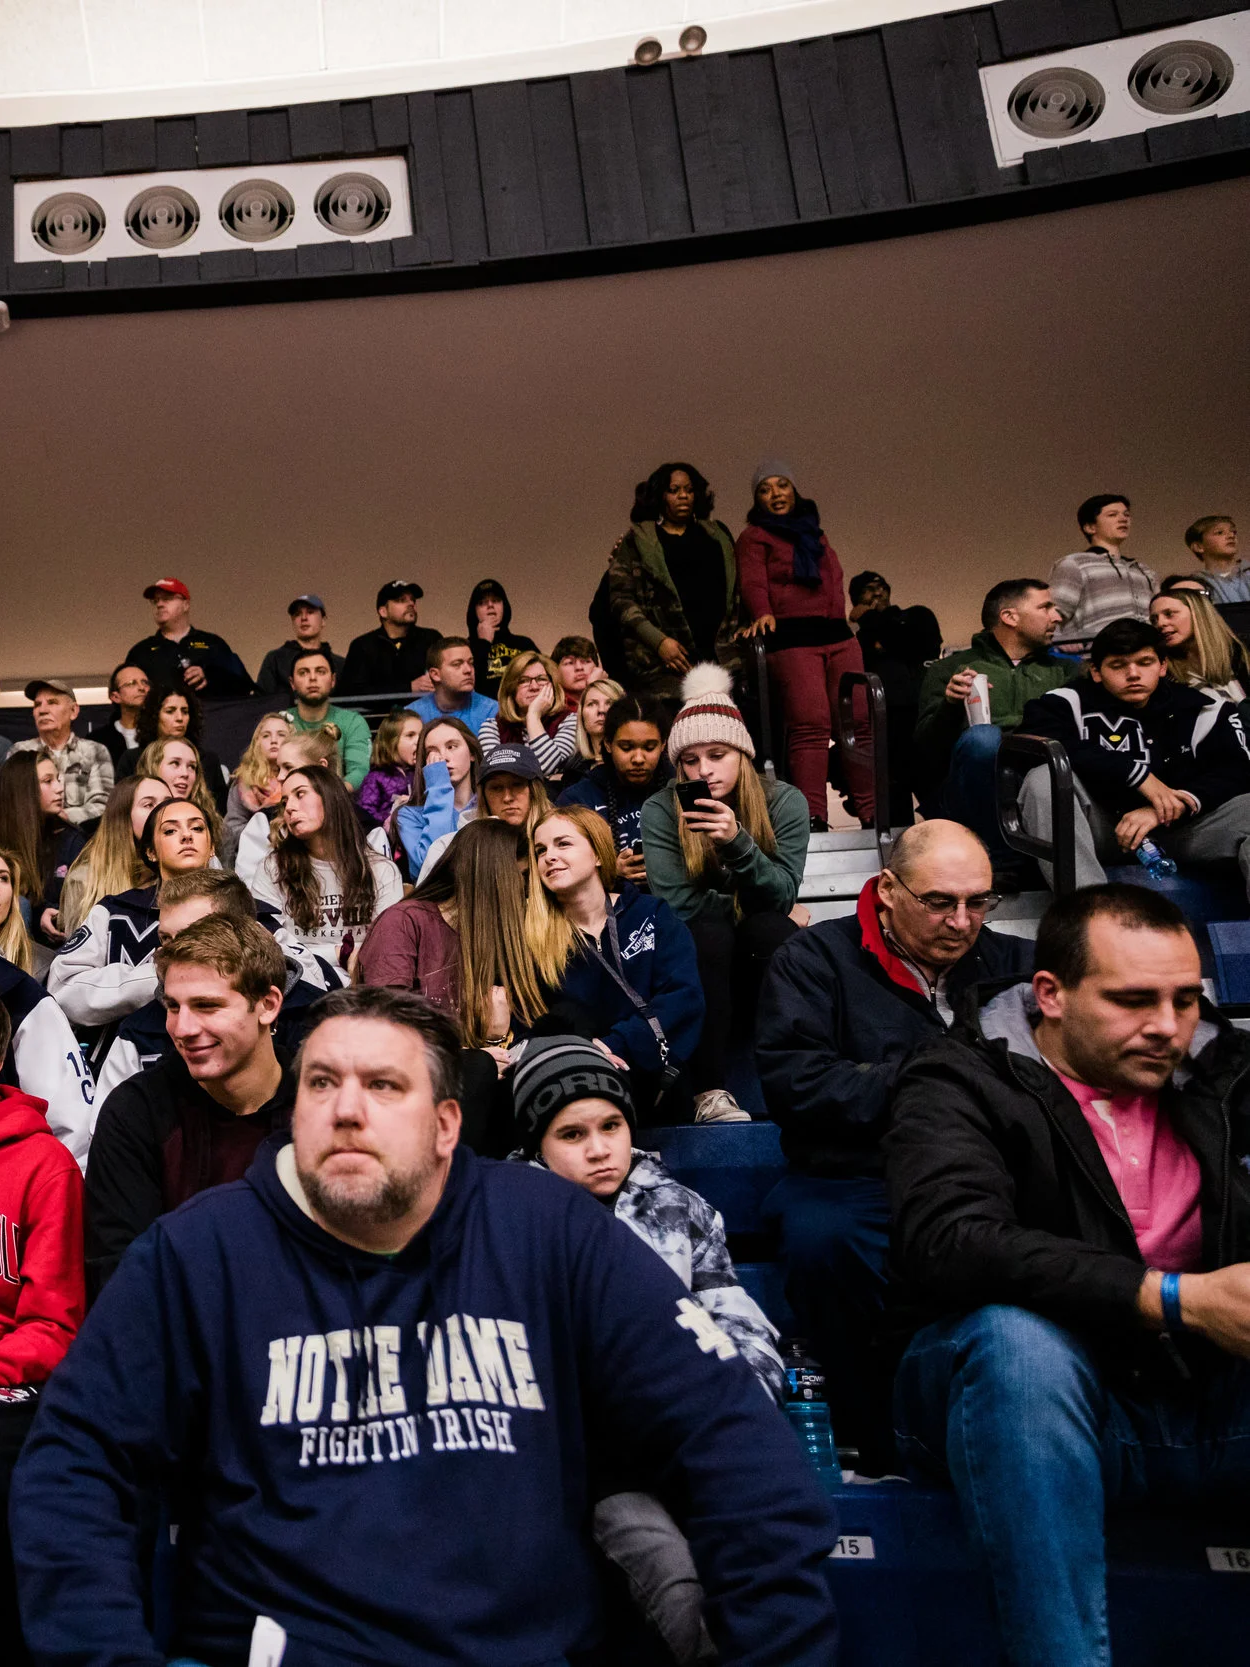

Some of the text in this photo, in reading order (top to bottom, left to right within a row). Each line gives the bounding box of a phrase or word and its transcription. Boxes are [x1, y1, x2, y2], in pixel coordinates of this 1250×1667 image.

[527, 1071, 634, 1132] JORD
[417, 1313, 546, 1411] DAME
[427, 1407, 517, 1453] IRISH
[837, 1538, 860, 1556] 15
[1220, 1550, 1250, 1569] 16
